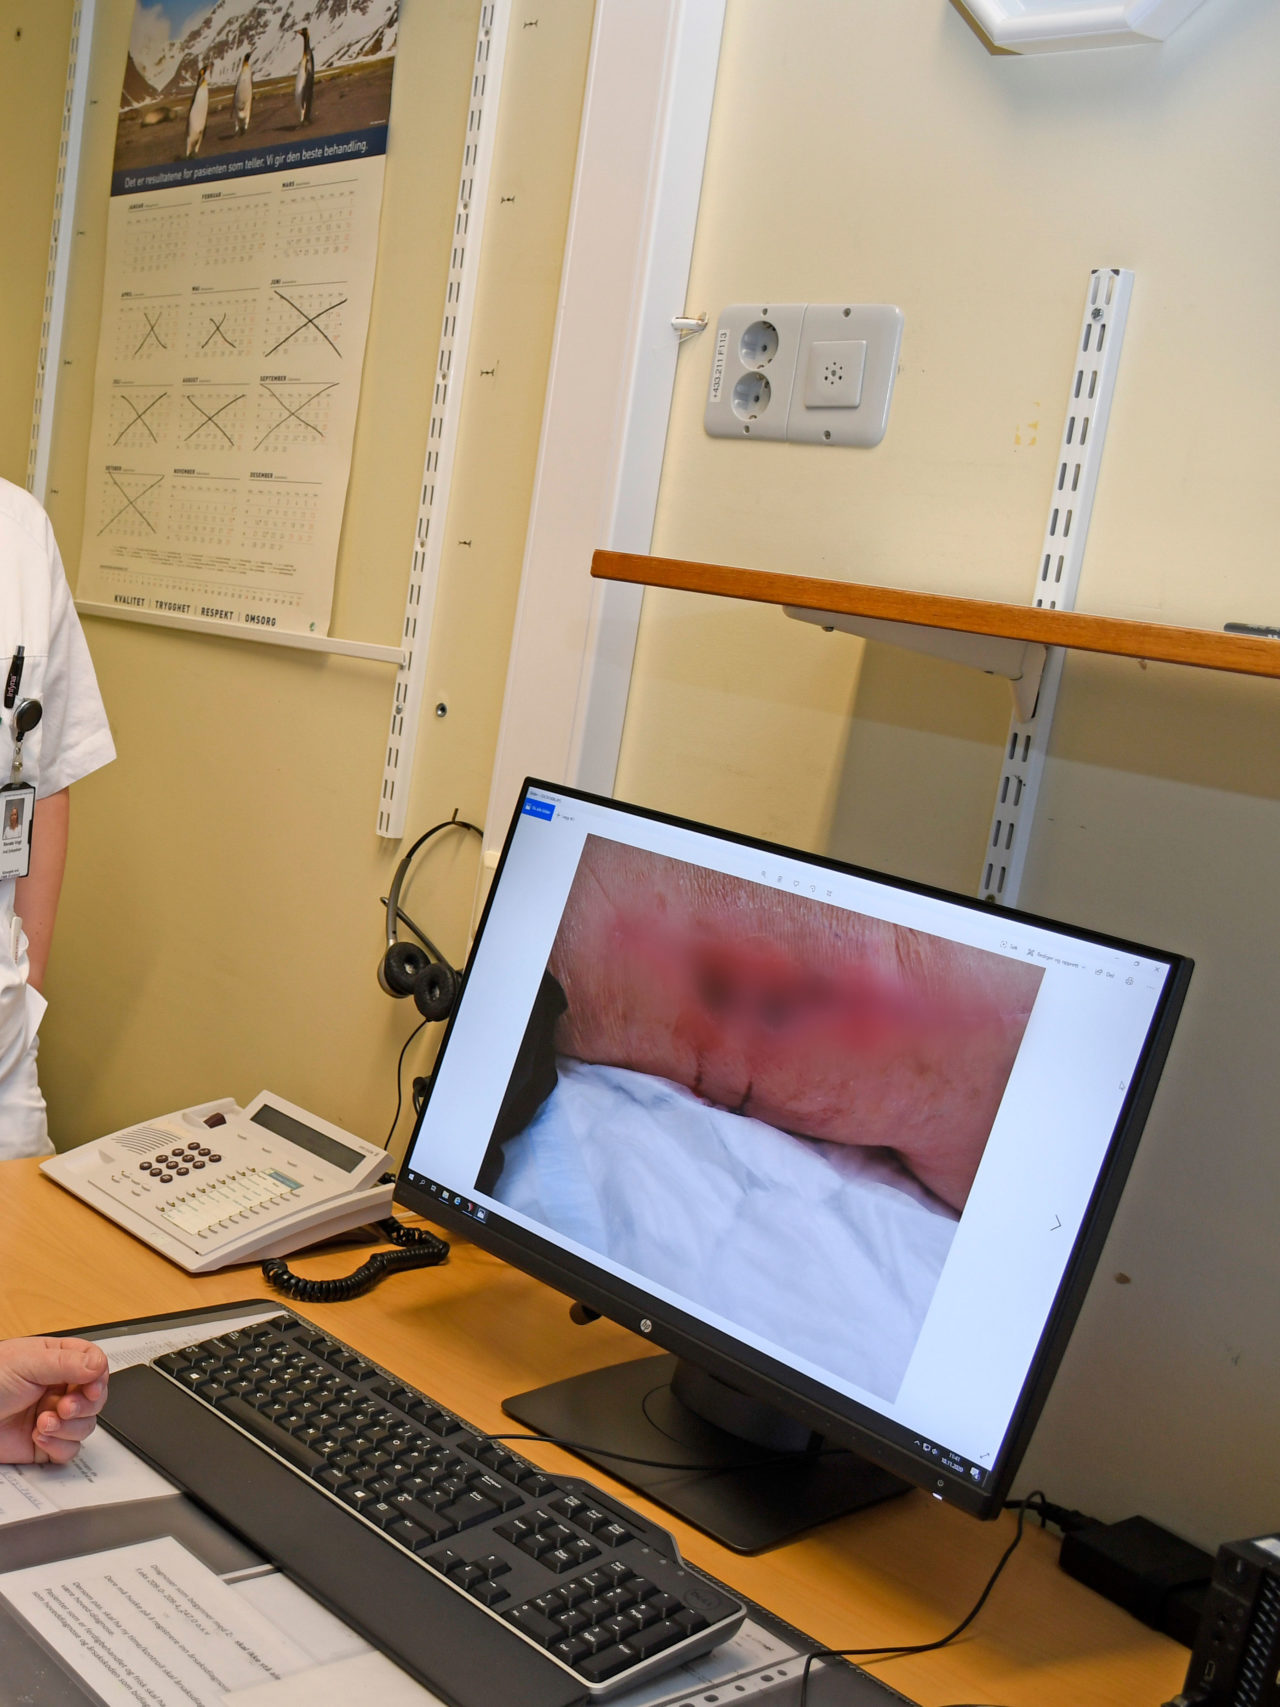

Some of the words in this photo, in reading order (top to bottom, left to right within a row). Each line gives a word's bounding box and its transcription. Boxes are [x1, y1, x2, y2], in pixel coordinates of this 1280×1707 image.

[124, 176, 136, 188] Det
[136, 178, 145, 186] er
[145, 170, 182, 185] resultatene
[183, 168, 193, 180] for
[194, 163, 227, 181] pasienten
[228, 161, 244, 174] som
[244, 157, 265, 170] teller.
[266, 154, 274, 166] Vi
[275, 152, 285, 168] gir
[286, 149, 301, 163] den
[301, 147, 323, 161] beste
[323, 140, 368, 158] behandling.
[114, 594, 145, 607] KVALITET
[155, 600, 191, 614] TRYGGHET
[201, 607, 234, 620] RESPEKT
[245, 613, 276, 626] OMSORG
